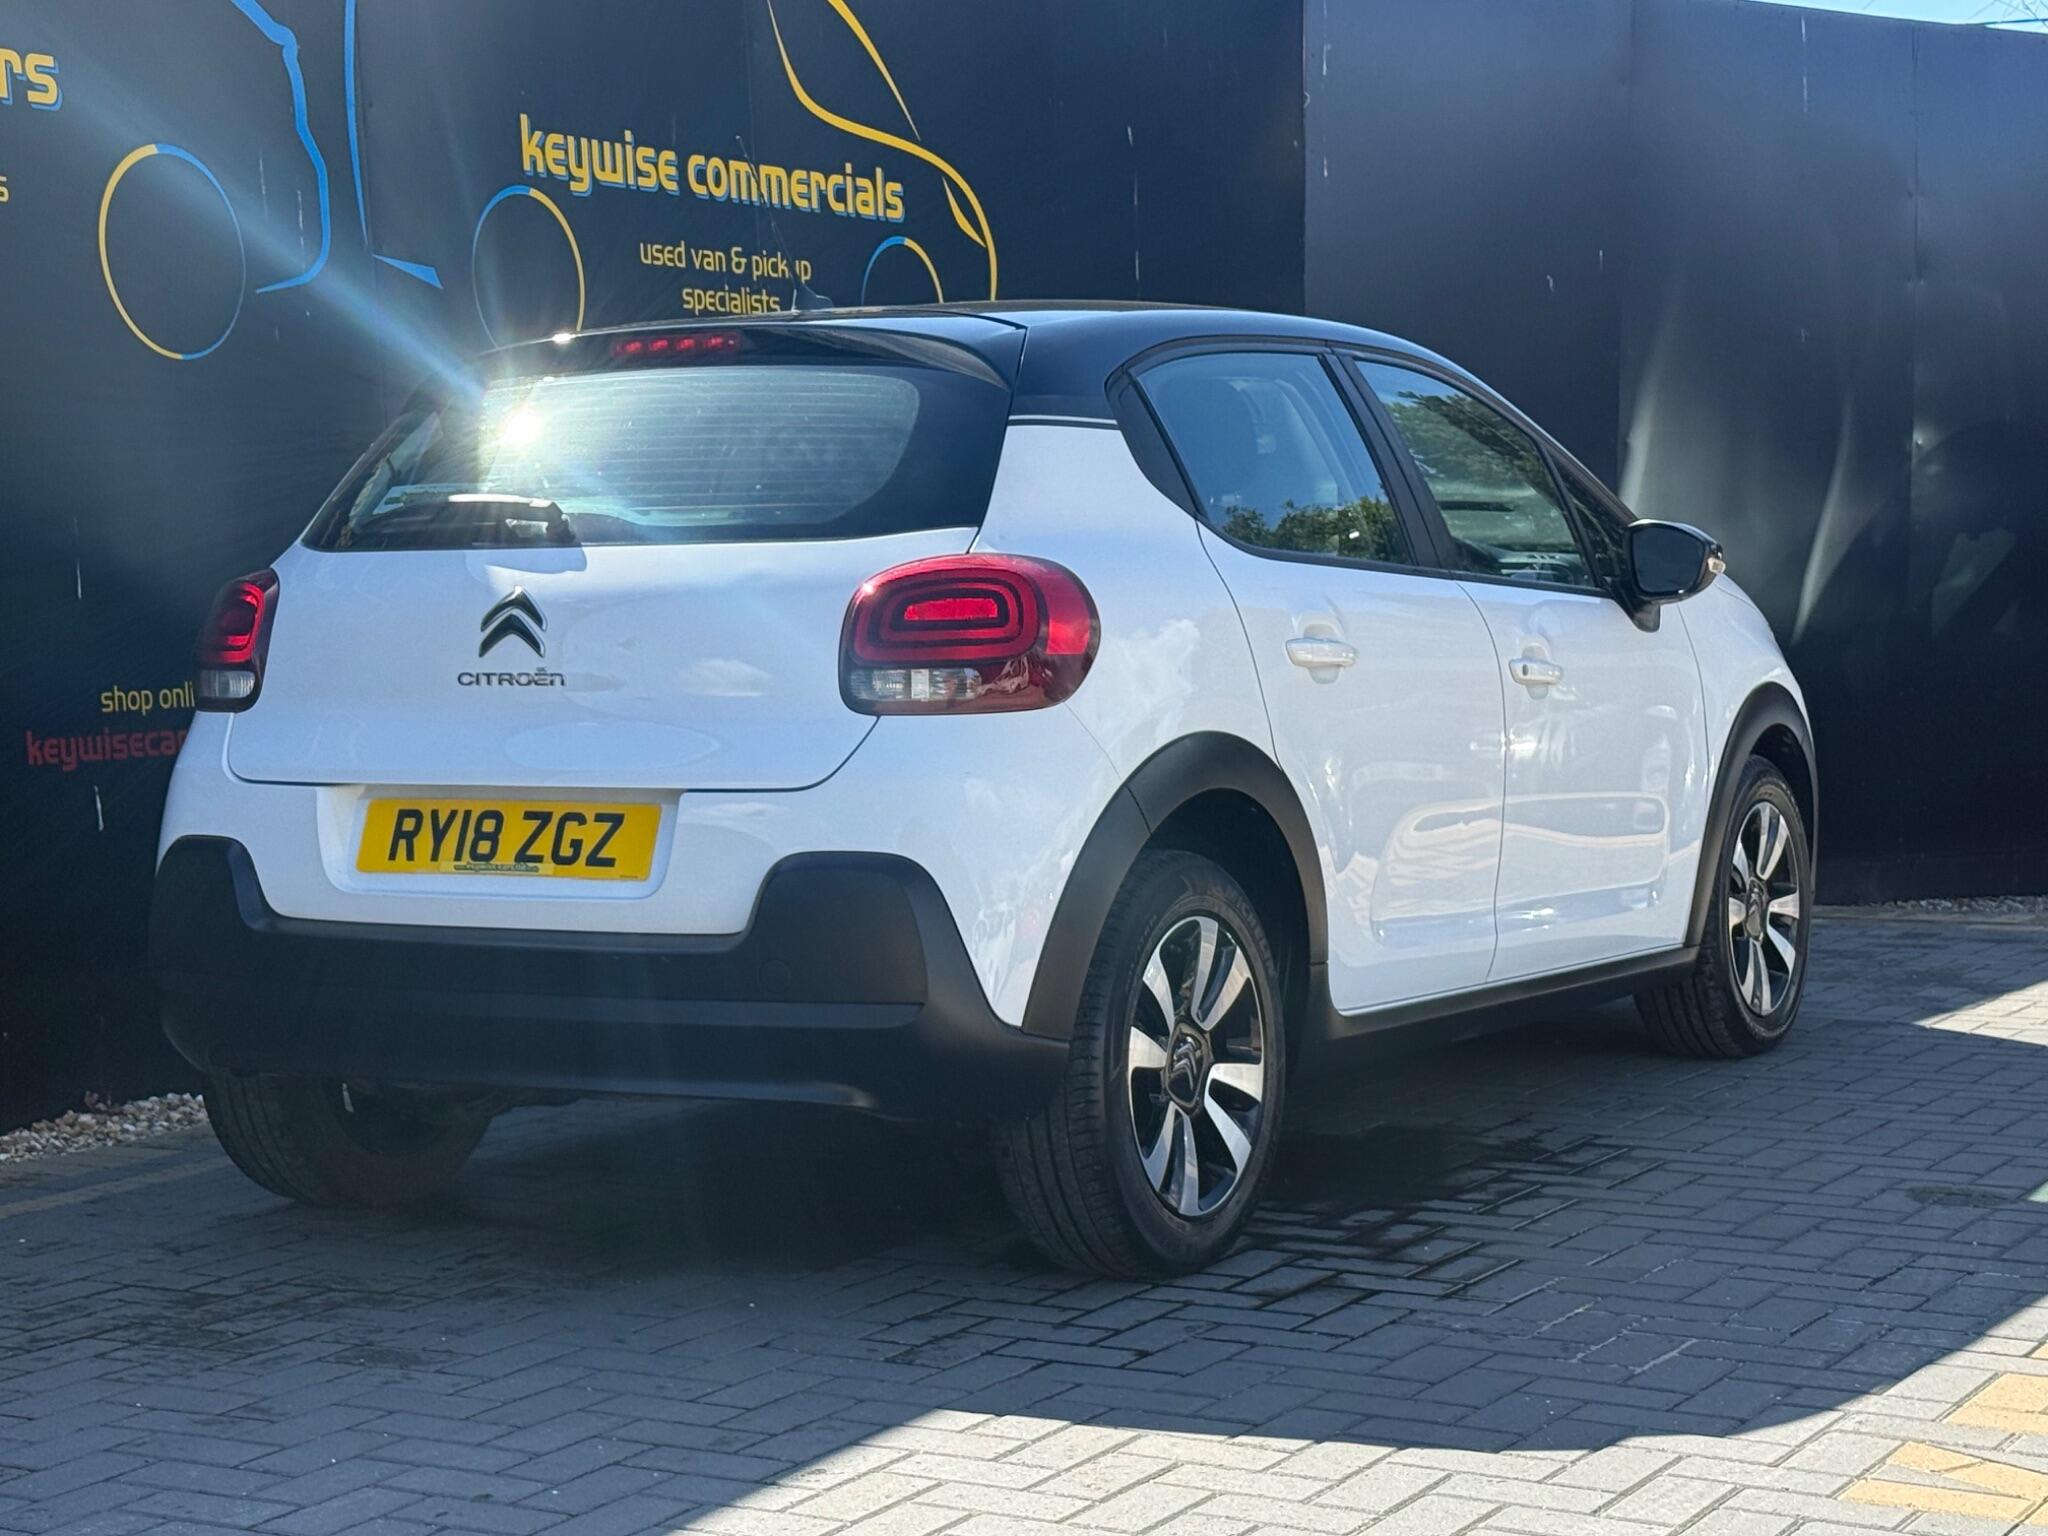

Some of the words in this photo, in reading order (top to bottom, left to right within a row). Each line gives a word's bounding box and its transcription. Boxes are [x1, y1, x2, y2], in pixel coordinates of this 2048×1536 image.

[520, 113, 680, 197] keywise
[687, 154, 904, 222] commercials
[640, 240, 686, 268] used
[691, 248, 727, 273] van
[731, 246, 747, 274] &
[682, 283, 781, 316] specialists
[101, 685, 153, 715] shop
[159, 681, 196, 708] onli
[387, 808, 505, 863] RY18
[514, 810, 626, 868] ZGZ
